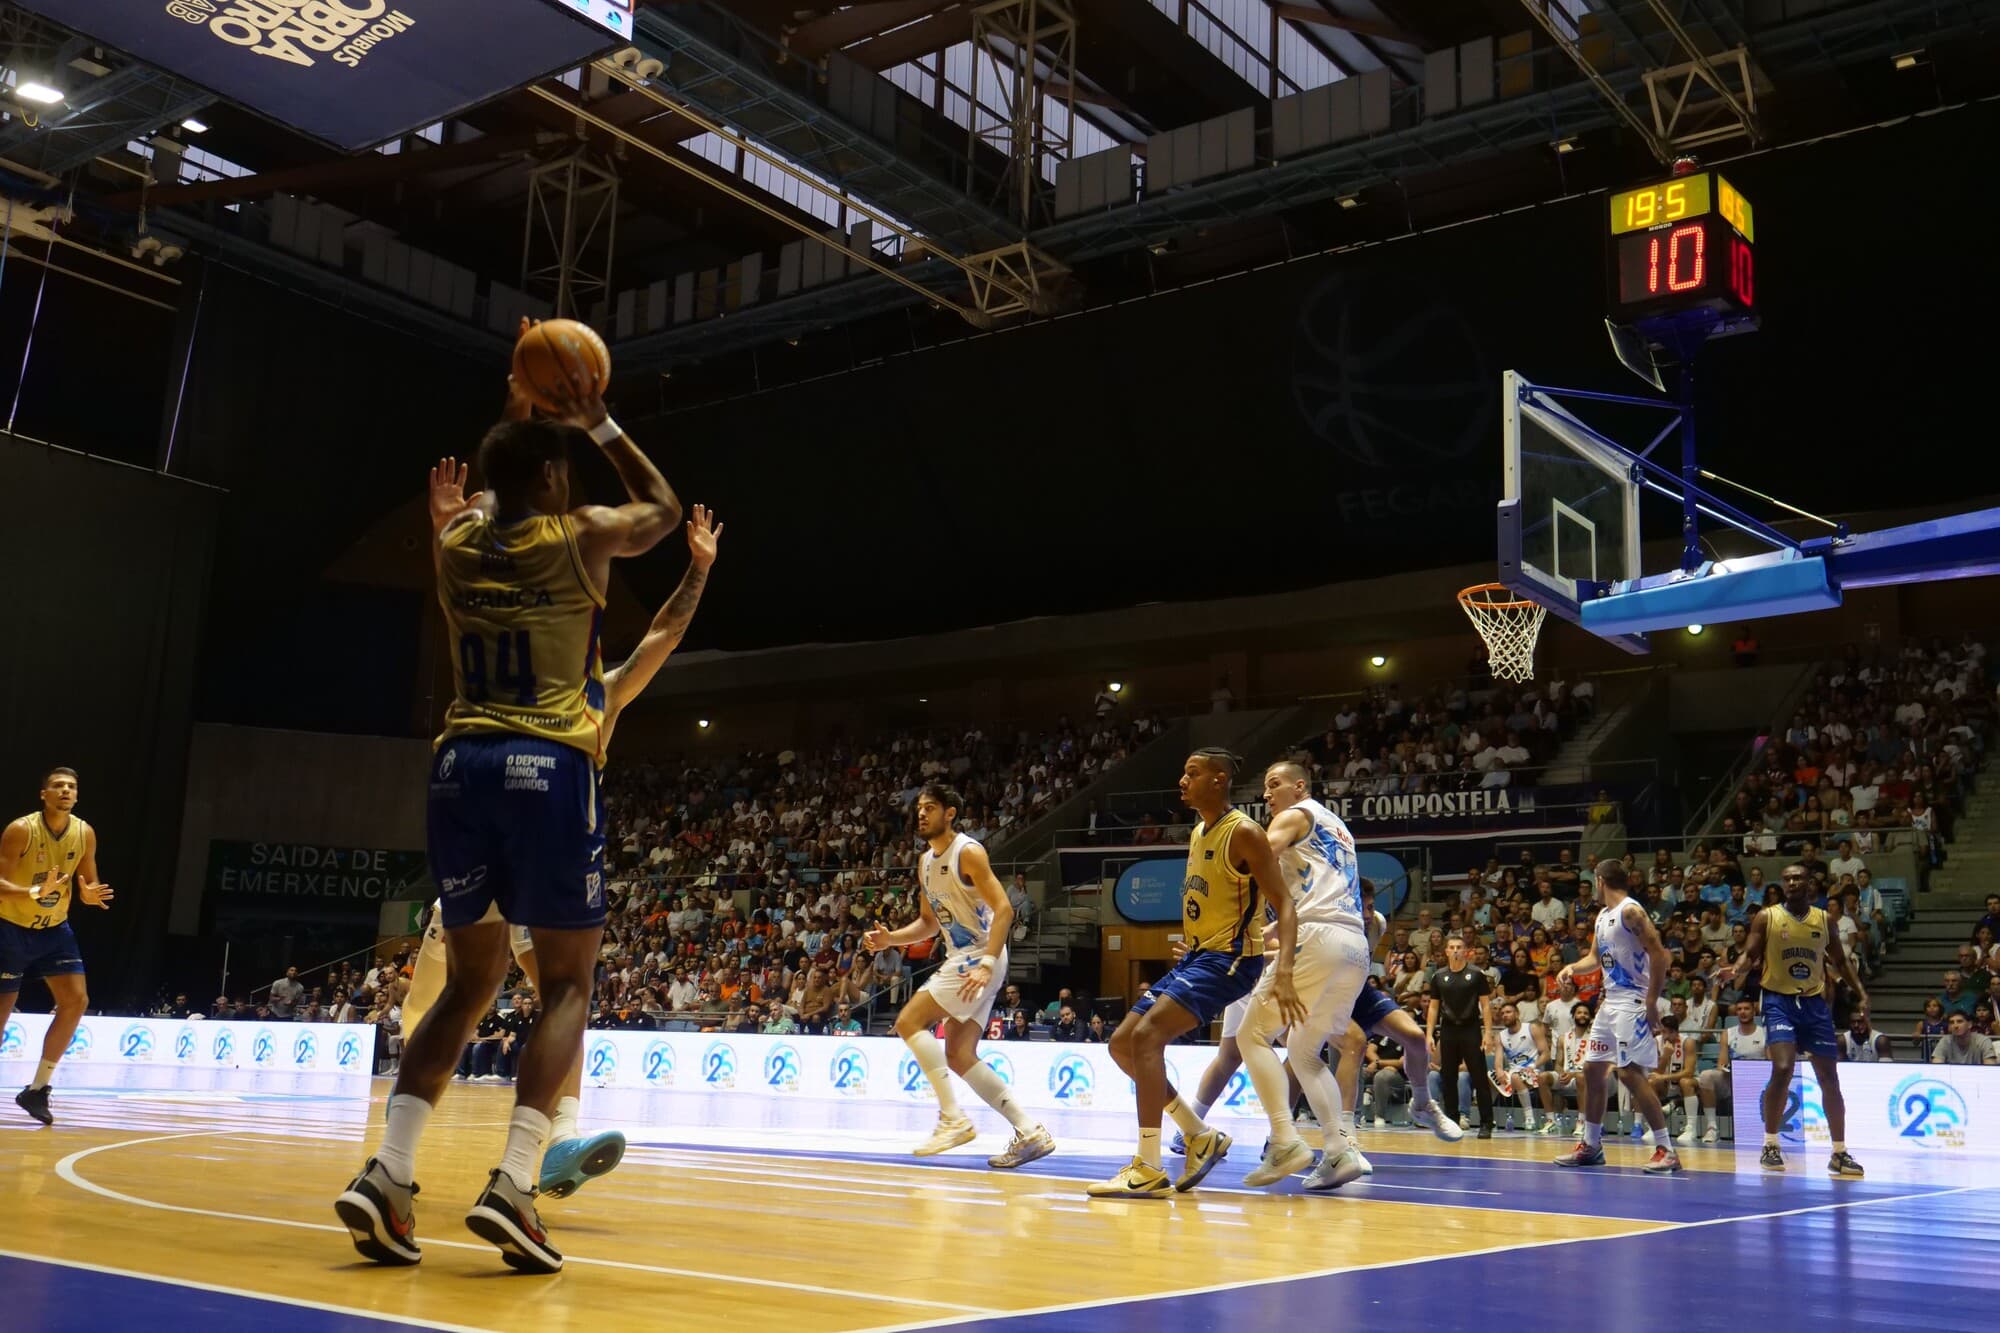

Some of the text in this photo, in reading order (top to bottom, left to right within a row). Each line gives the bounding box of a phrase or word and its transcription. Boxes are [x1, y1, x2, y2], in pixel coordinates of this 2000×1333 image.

[332, 9, 416, 68] MONBUS
[1627, 183, 1685, 227] 19:5
[1649, 225, 1704, 293] 10
[461, 628, 538, 706] 94
[504, 766, 539, 778] FAINOS
[515, 754, 557, 770] DEPORTE
[504, 778, 550, 792] GRANDES
[1361, 788, 1512, 822] COMPOSTELA
[250, 841, 390, 873] SAIDA DE
[220, 866, 409, 899] EMERXENCIA
[991, 1021, 1003, 1038] 5
[1899, 1088, 1960, 1137] 25
